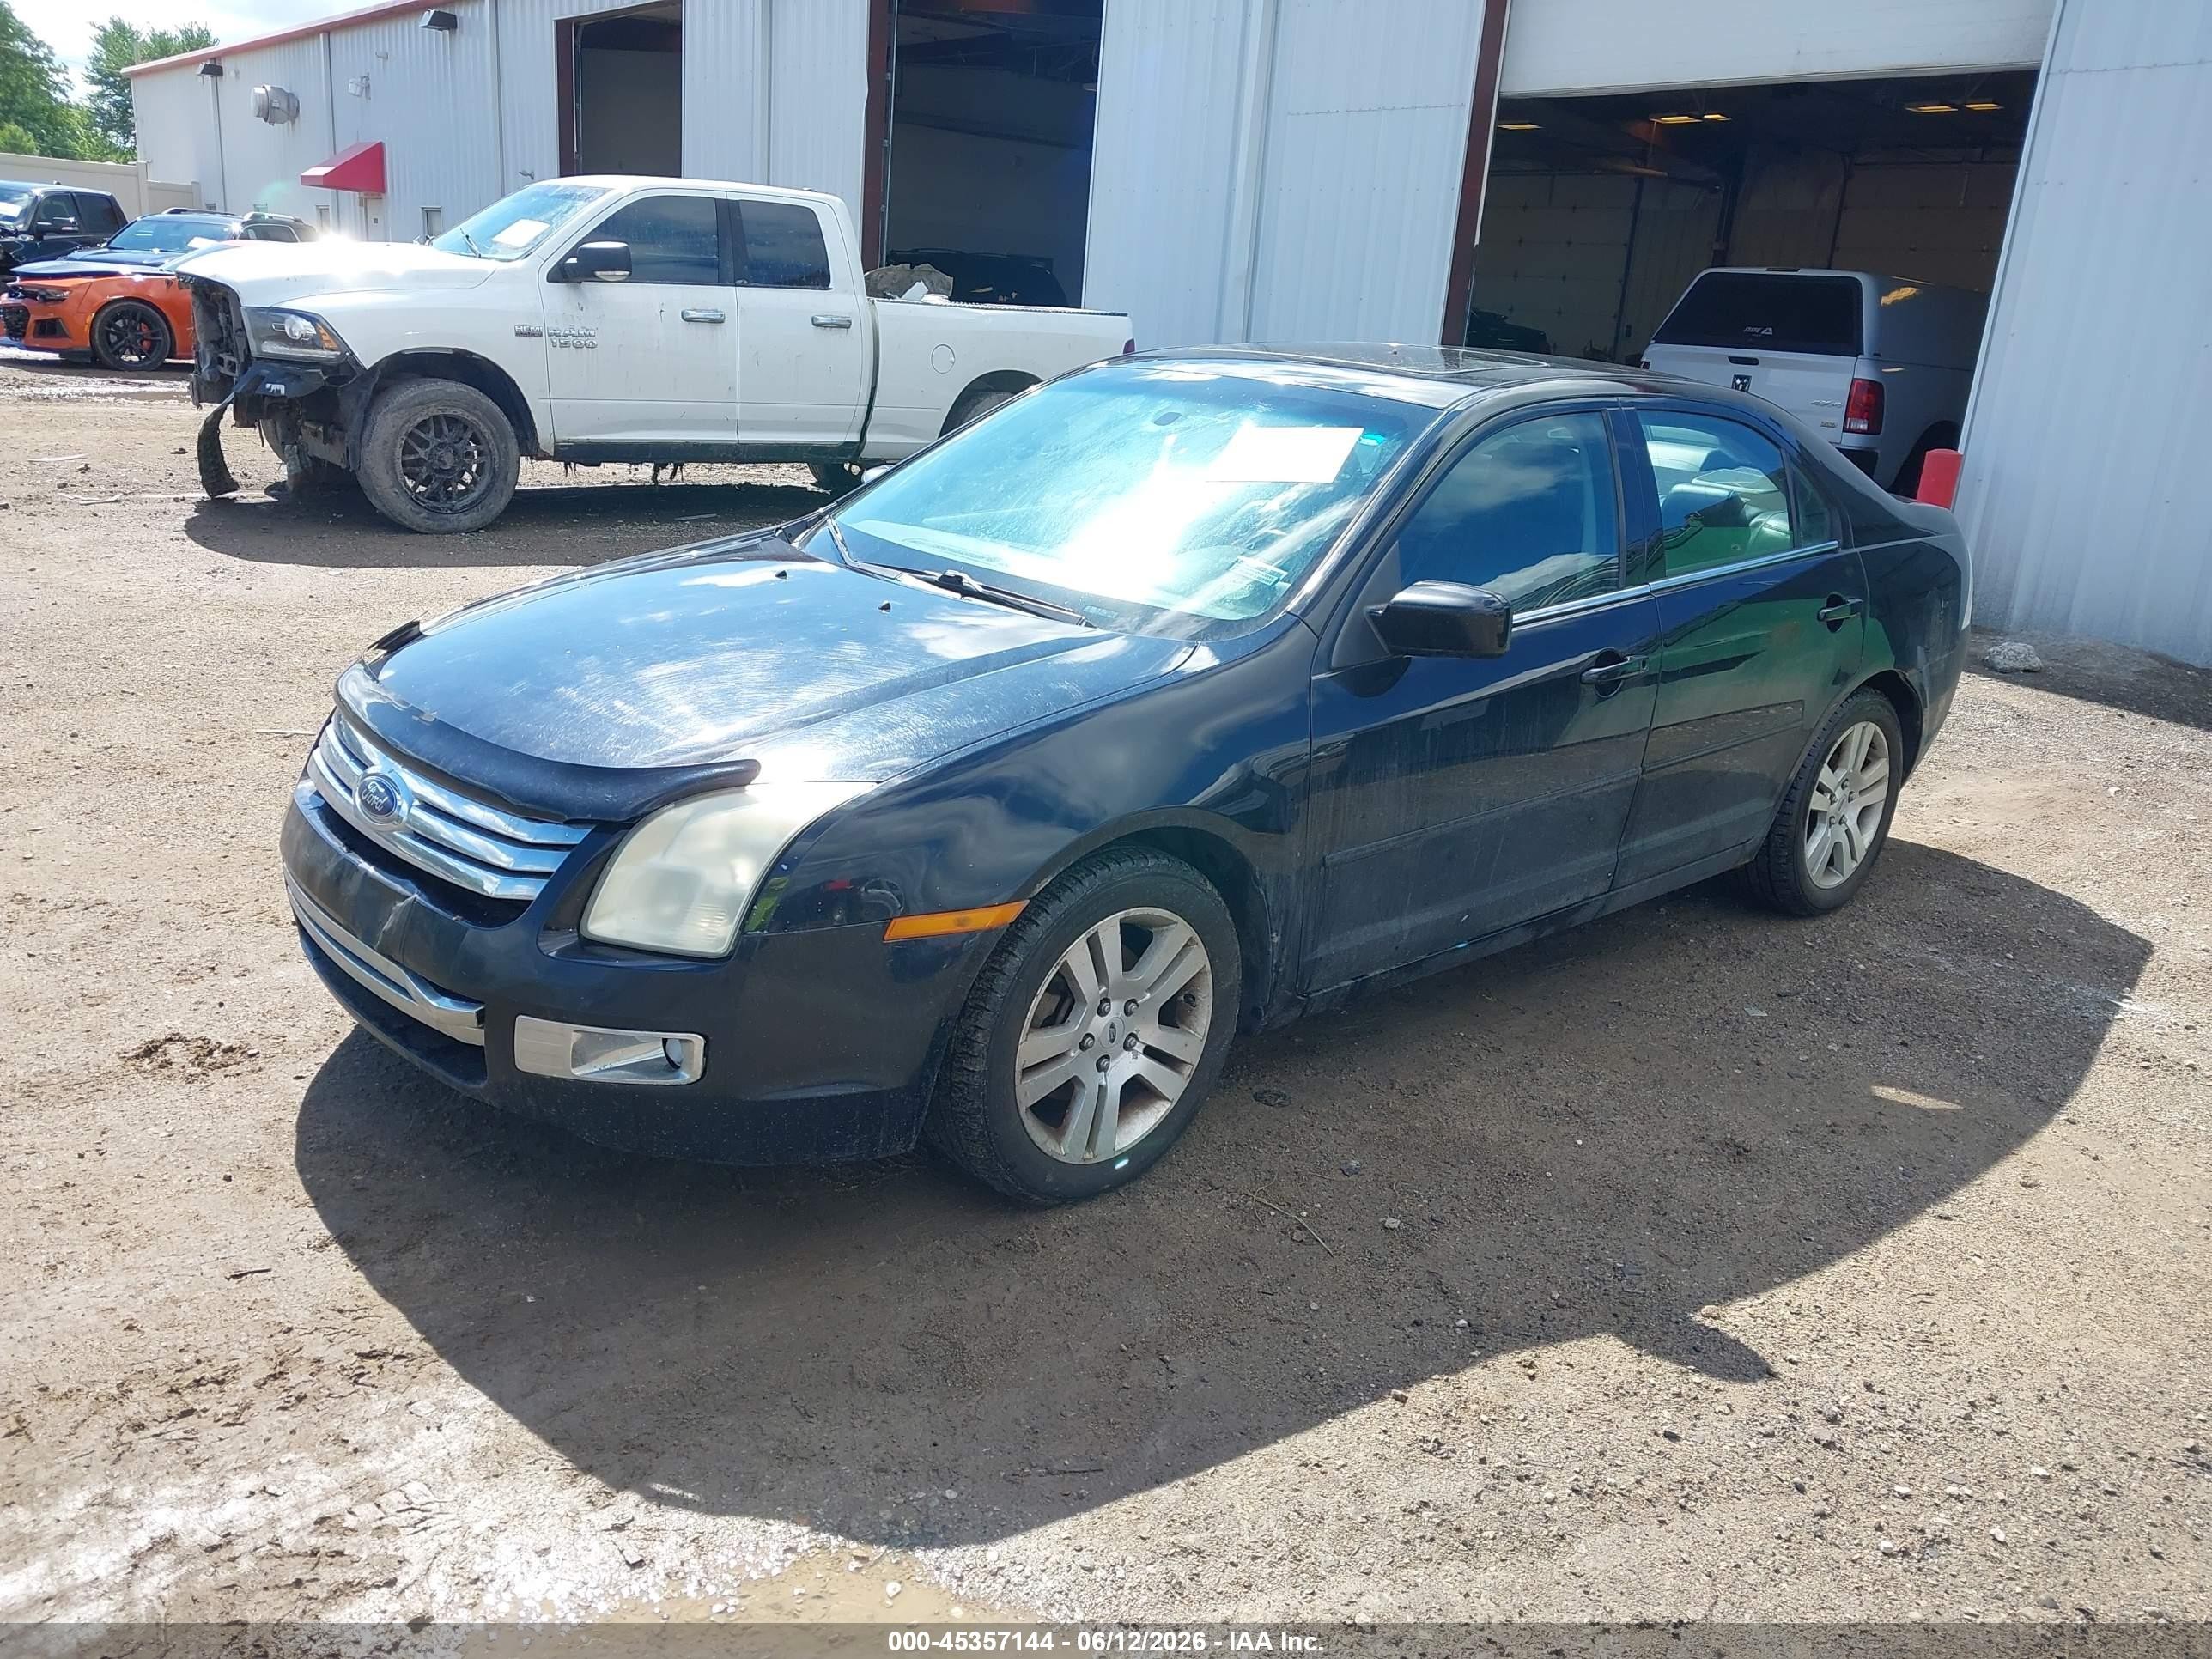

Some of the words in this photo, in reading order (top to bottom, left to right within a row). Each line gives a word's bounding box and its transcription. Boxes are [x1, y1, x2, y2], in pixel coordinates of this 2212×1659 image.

[547, 327, 596, 337] RAM
[550, 337, 598, 349] 1500
[362, 781, 389, 811] Ford
